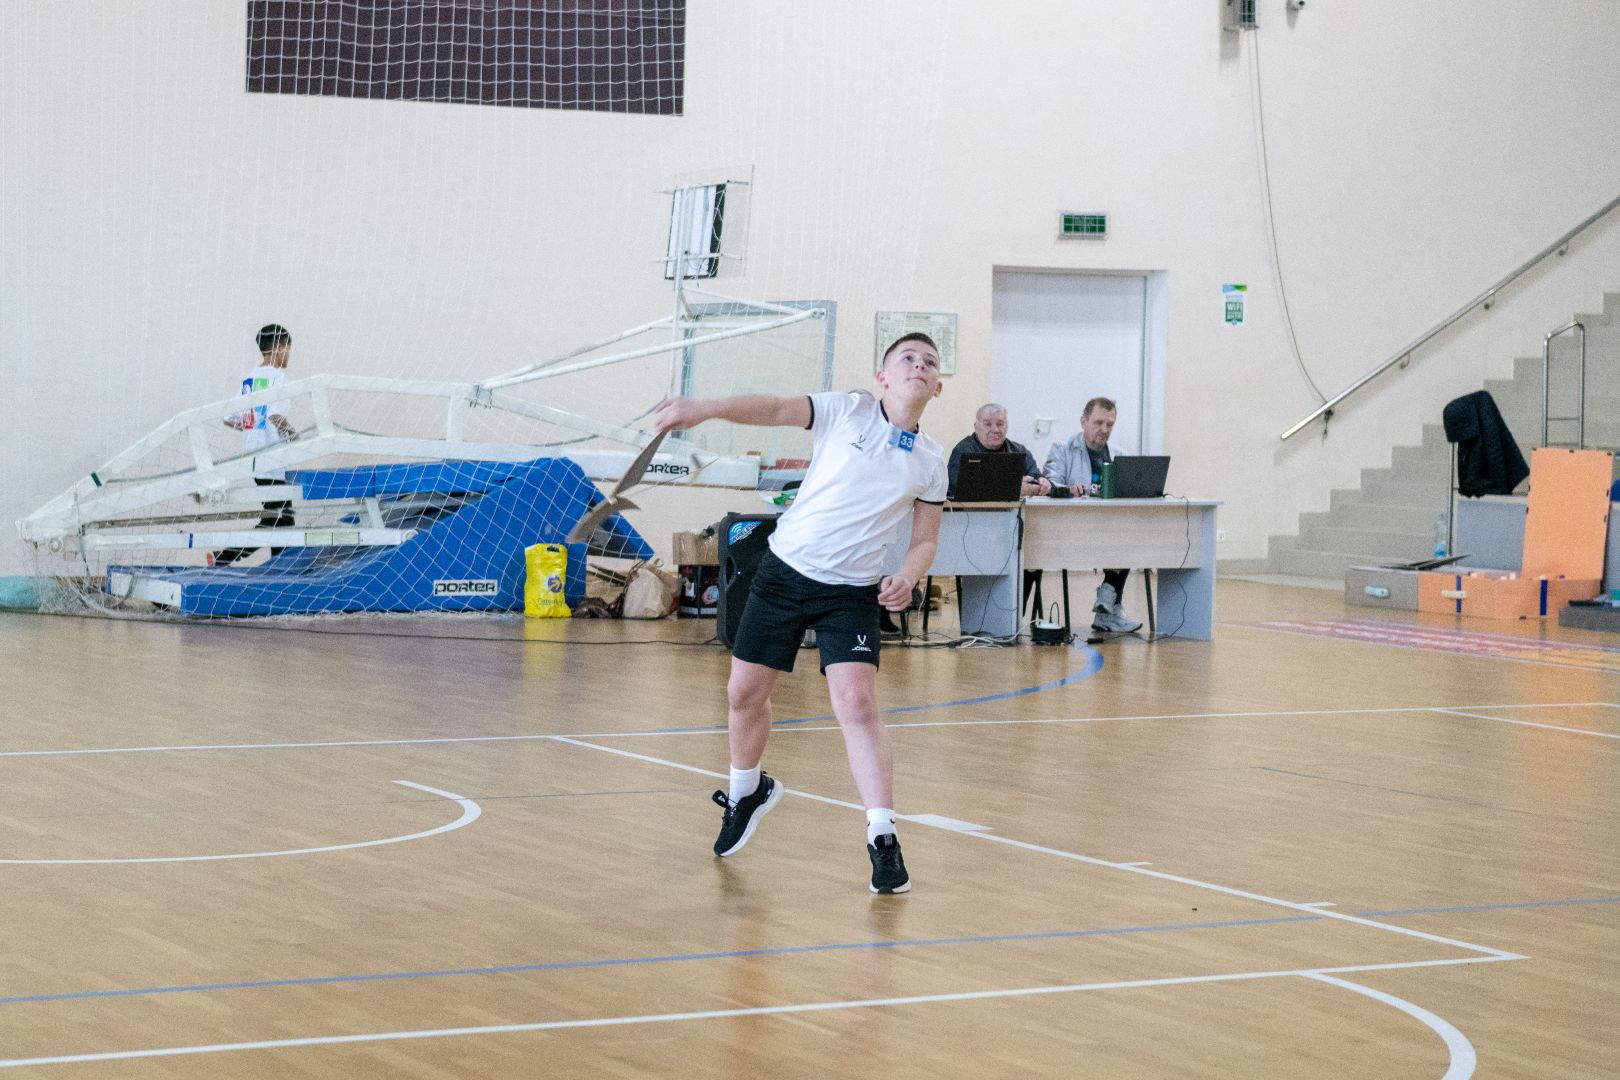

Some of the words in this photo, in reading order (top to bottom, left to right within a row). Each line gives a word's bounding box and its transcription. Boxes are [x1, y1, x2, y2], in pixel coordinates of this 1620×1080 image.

[900, 435, 913, 448] 33
[645, 462, 690, 476] orter
[434, 581, 495, 595] porter
